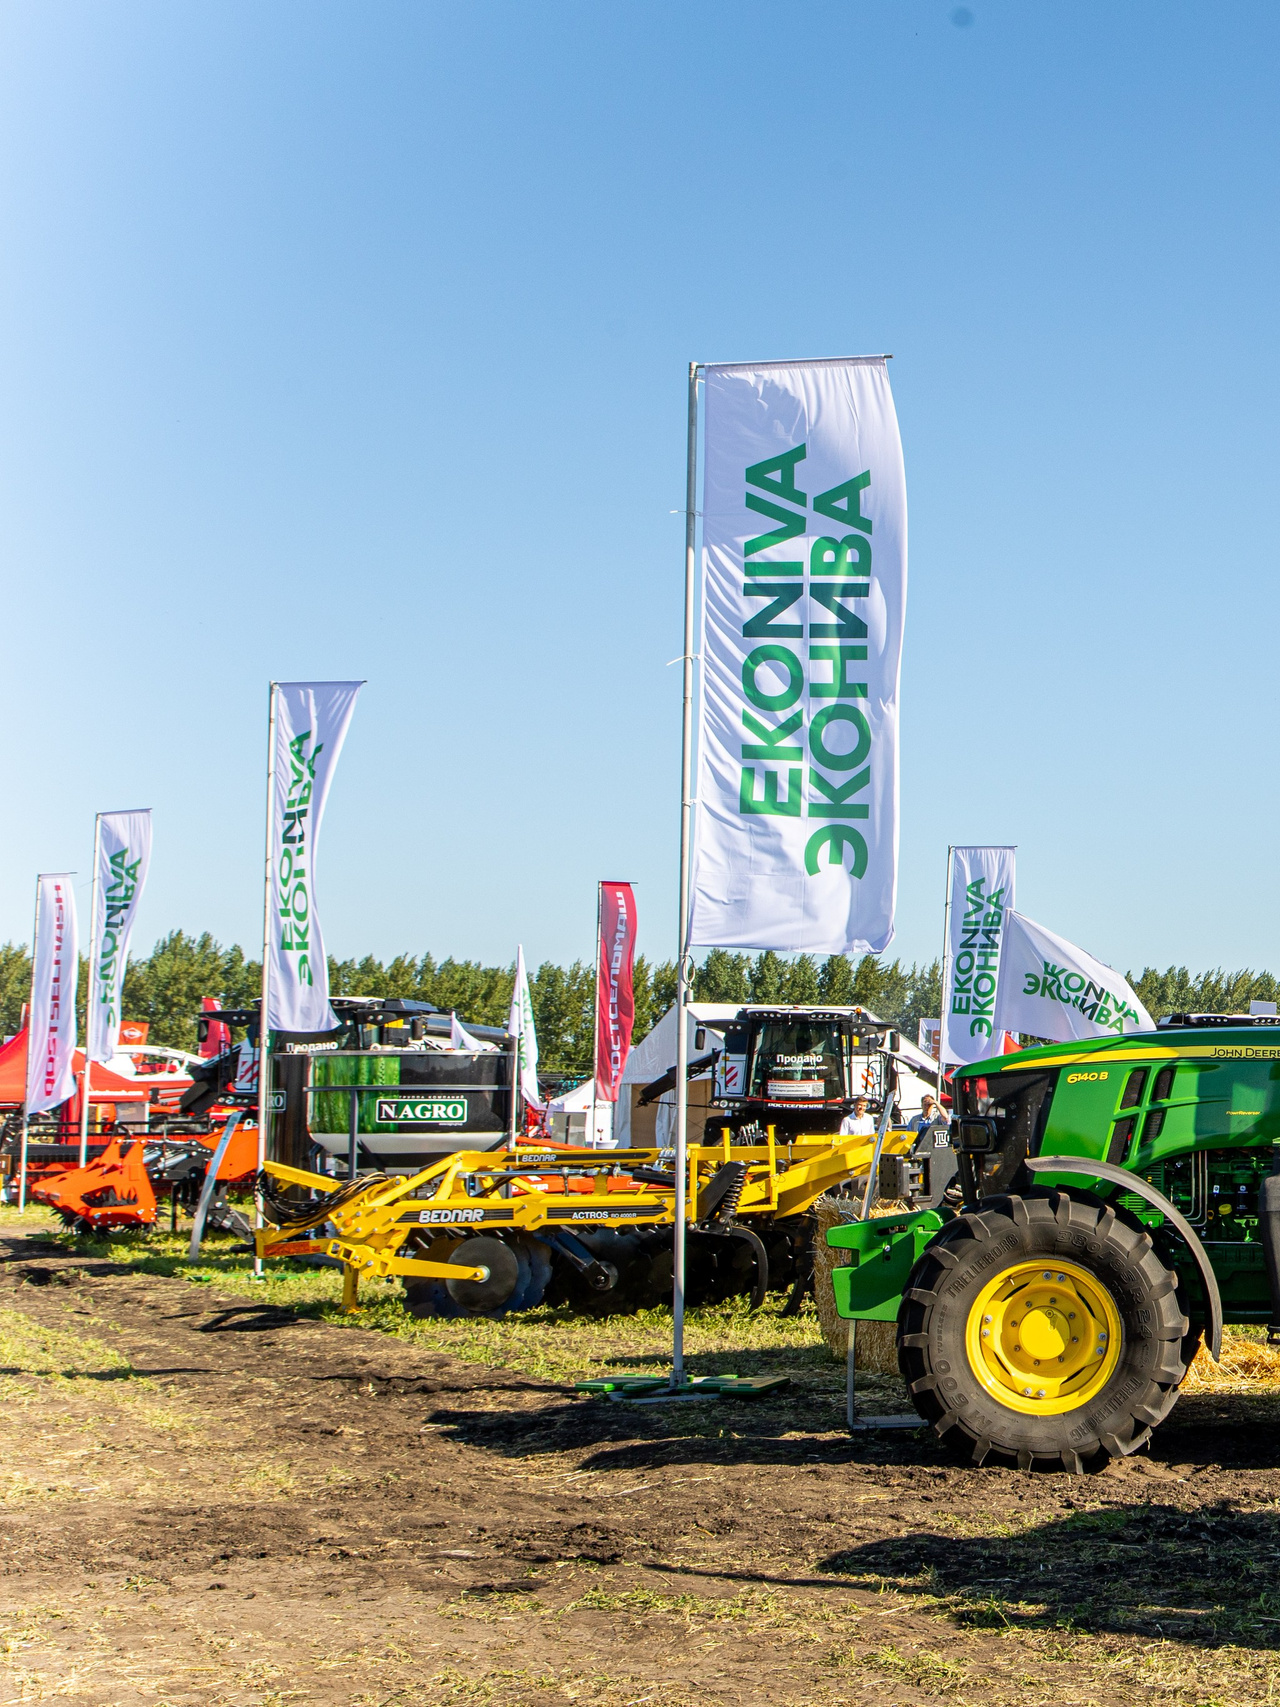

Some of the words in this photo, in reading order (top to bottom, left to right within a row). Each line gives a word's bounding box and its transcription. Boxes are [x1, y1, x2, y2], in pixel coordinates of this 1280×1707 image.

[740, 442, 808, 818] EKONIVA
[804, 468, 873, 880] ЭКОНИВА
[952, 877, 985, 1015] EKONIVA
[970, 888, 1004, 1038] ЭКОНИВА
[286, 1041, 338, 1055] Продано
[1210, 1047, 1243, 1058] JOHN
[776, 1053, 823, 1065] Продано
[1067, 1072, 1098, 1084] 6140
[522, 1154, 556, 1162] BEDNAR
[419, 1208, 484, 1223] BEDNAR
[572, 1211, 608, 1219] ACTROS
[944, 1234, 1019, 1299] TRELLEBORG
[1070, 1376, 1144, 1442] TRELLEBORG
